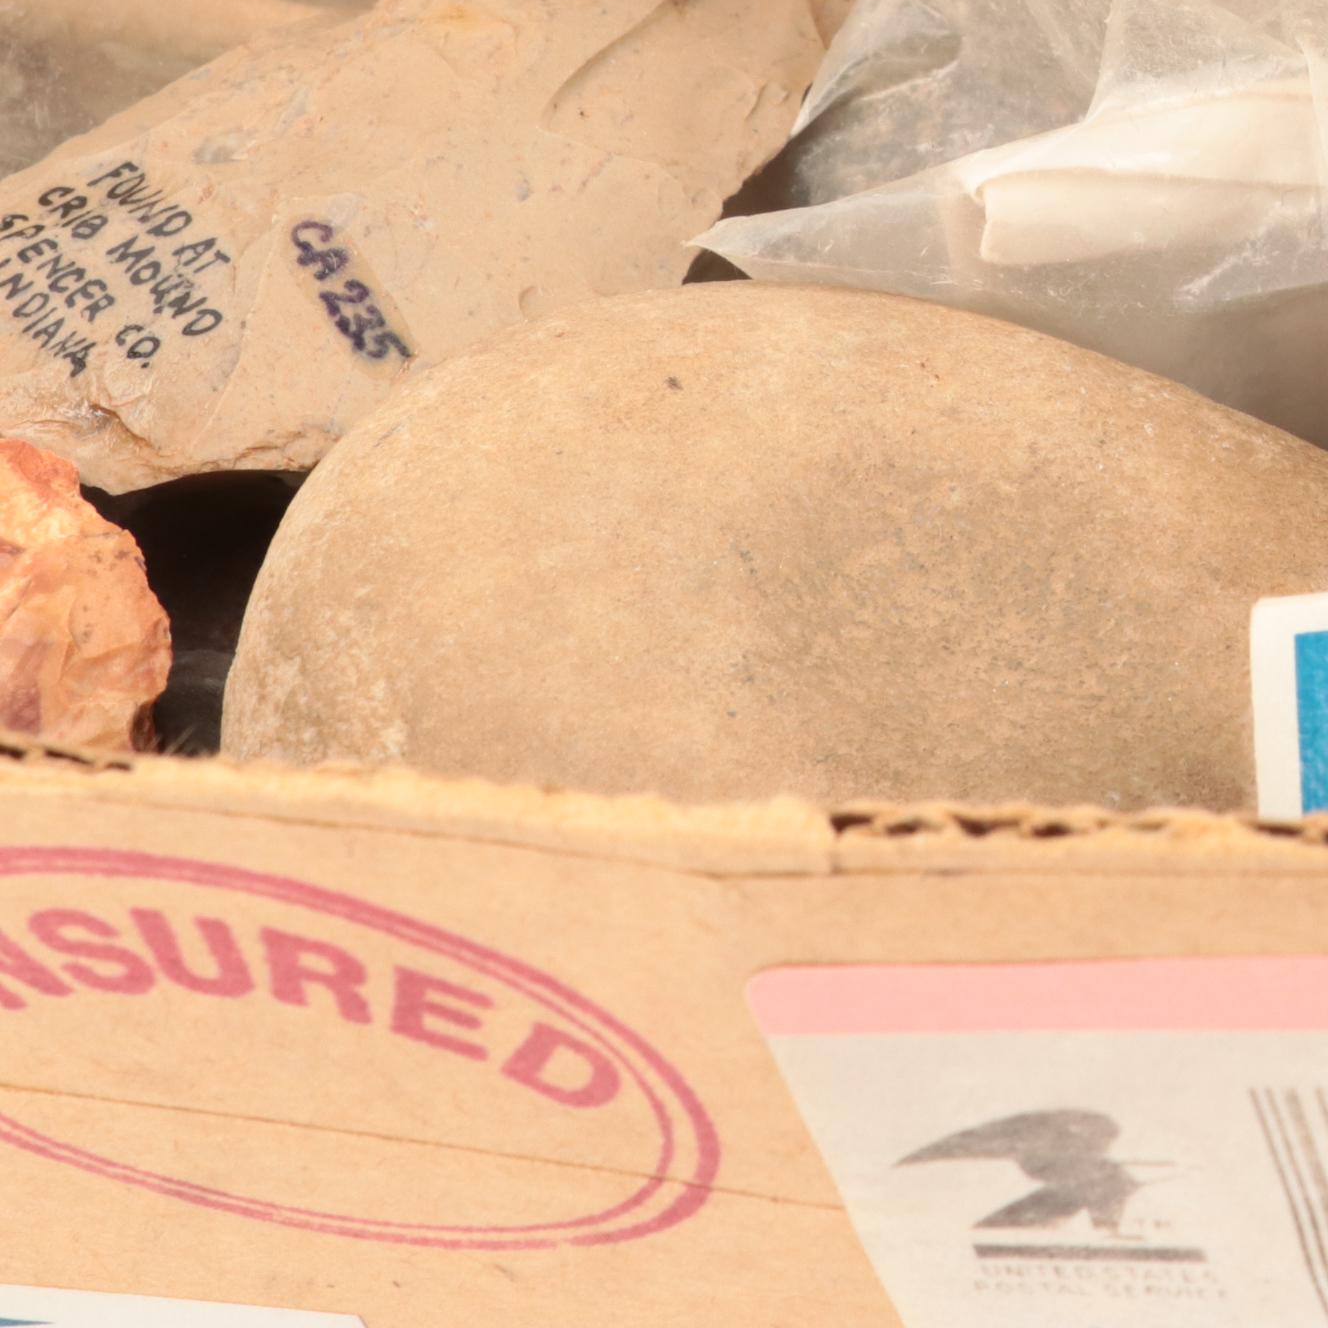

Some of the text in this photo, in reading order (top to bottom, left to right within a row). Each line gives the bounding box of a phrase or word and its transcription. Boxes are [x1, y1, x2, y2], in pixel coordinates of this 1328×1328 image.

[0, 214, 161, 369] SPENCER CO.
[37, 186, 223, 336] CRIB MOUND
[87, 161, 231, 274] FOUND AT
